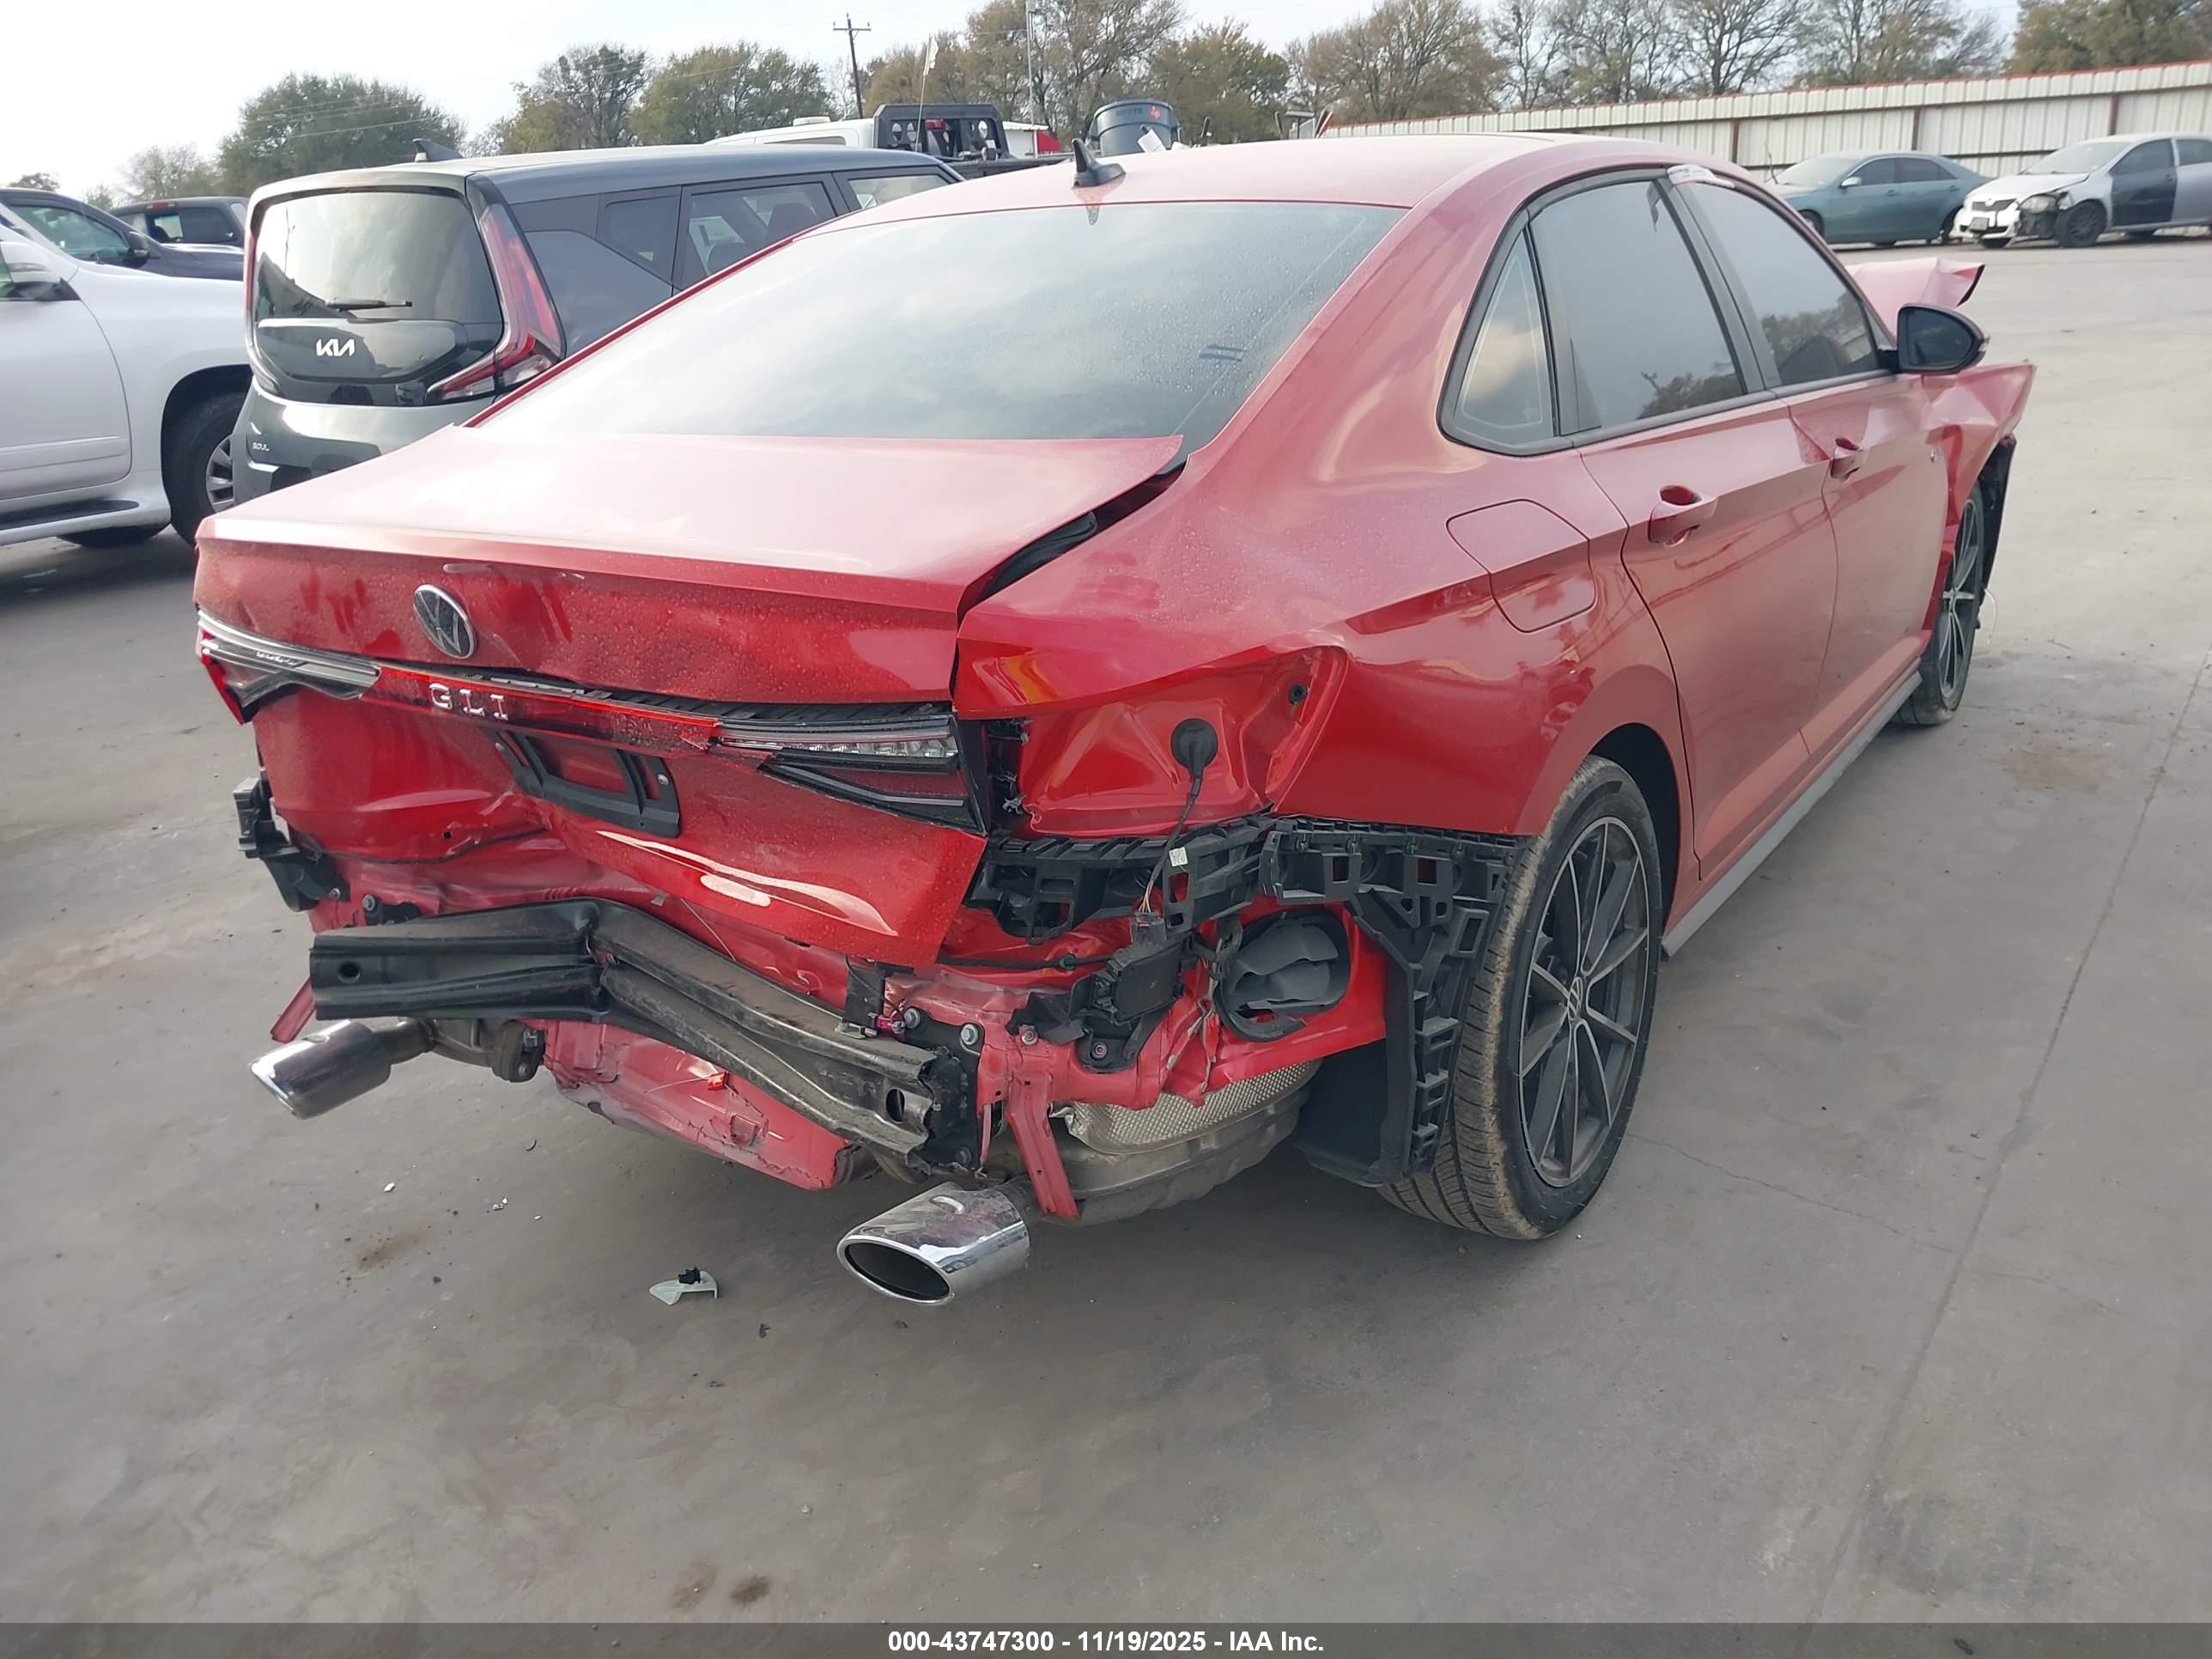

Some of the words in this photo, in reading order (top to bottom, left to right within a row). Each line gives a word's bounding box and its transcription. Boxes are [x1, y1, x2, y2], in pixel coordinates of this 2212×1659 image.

[316, 338, 355, 356] KIA
[252, 441, 270, 452] SOUL
[429, 683, 508, 720] GLI
